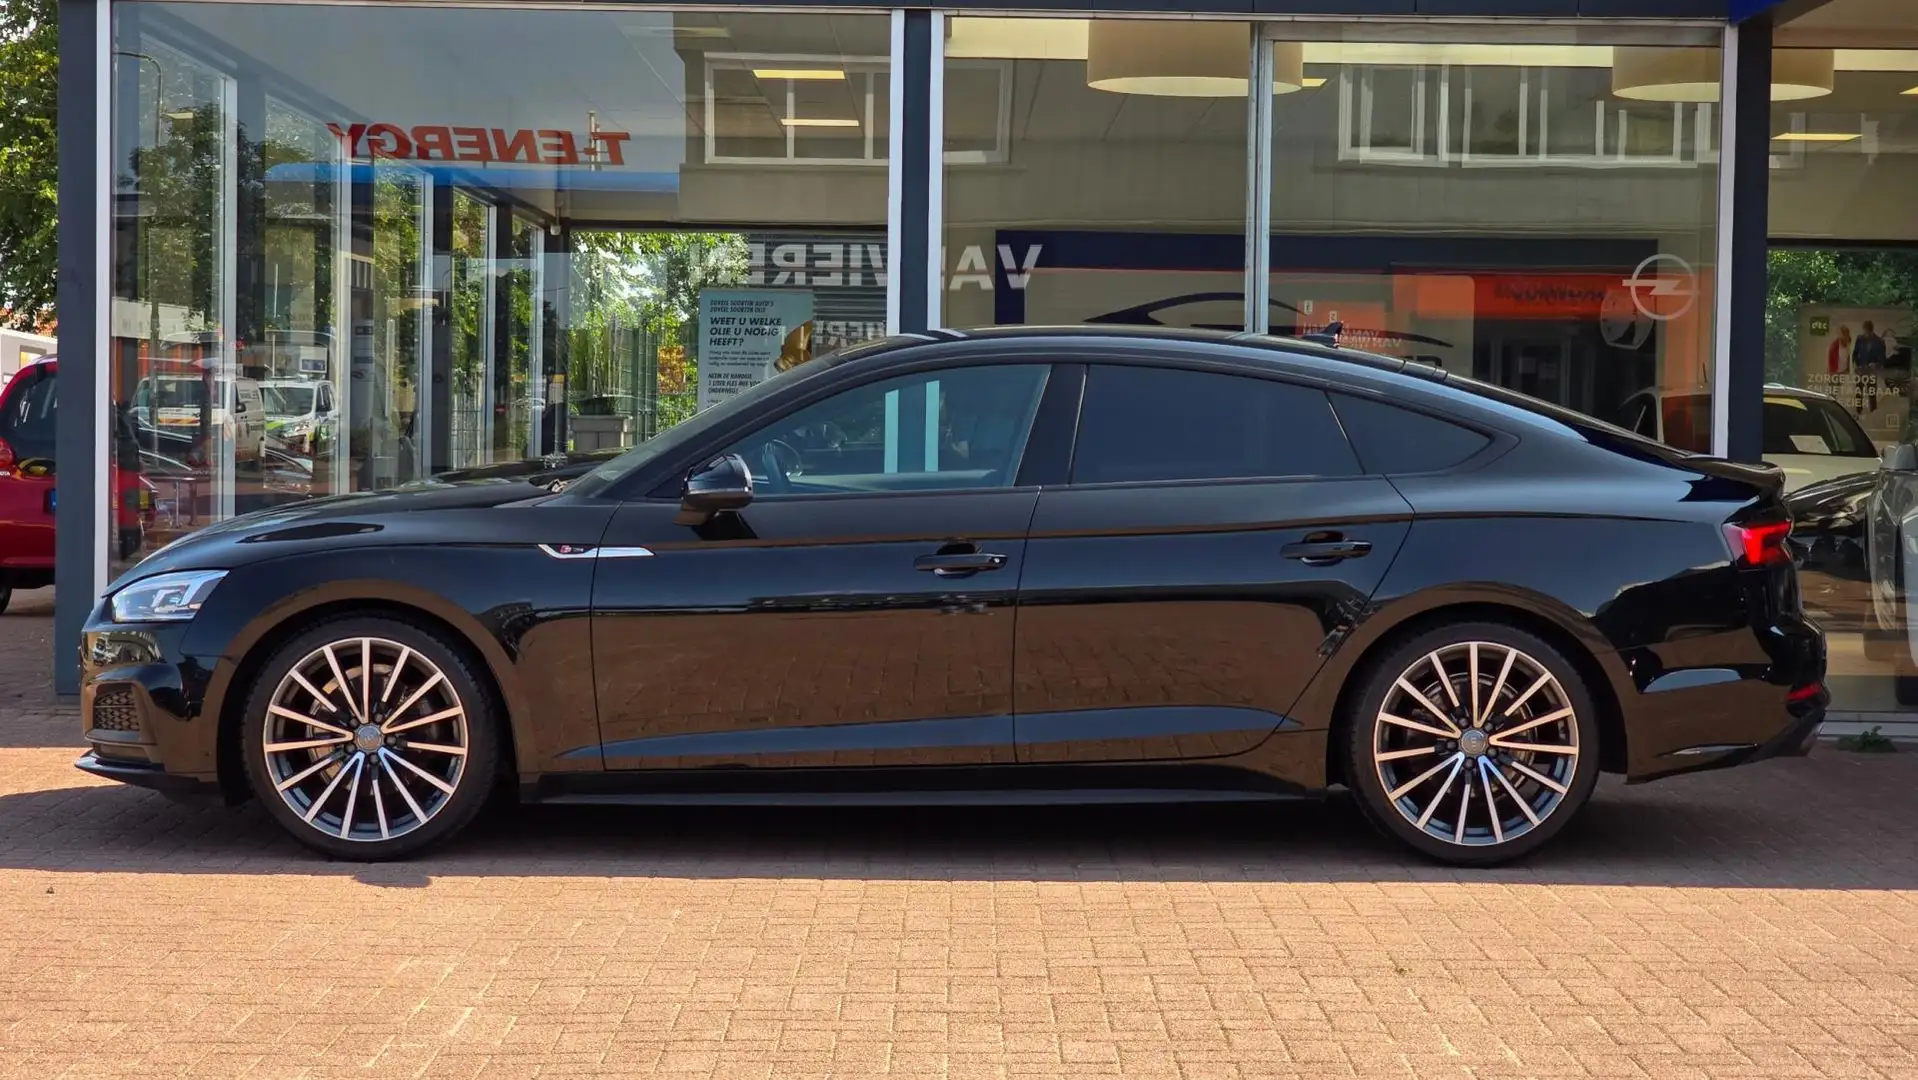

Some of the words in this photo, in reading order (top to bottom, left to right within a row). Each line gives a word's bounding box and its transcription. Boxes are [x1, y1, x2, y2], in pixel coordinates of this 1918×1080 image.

[709, 317, 736, 325] WEET
[739, 317, 746, 325] U
[749, 317, 782, 326] WELKE
[709, 327, 731, 336] OLIE
[733, 327, 742, 336] U
[744, 327, 779, 336] NODIG
[1807, 373, 1877, 384] ZORGELOOS
[1824, 385, 1901, 396] BETAALBAAR
